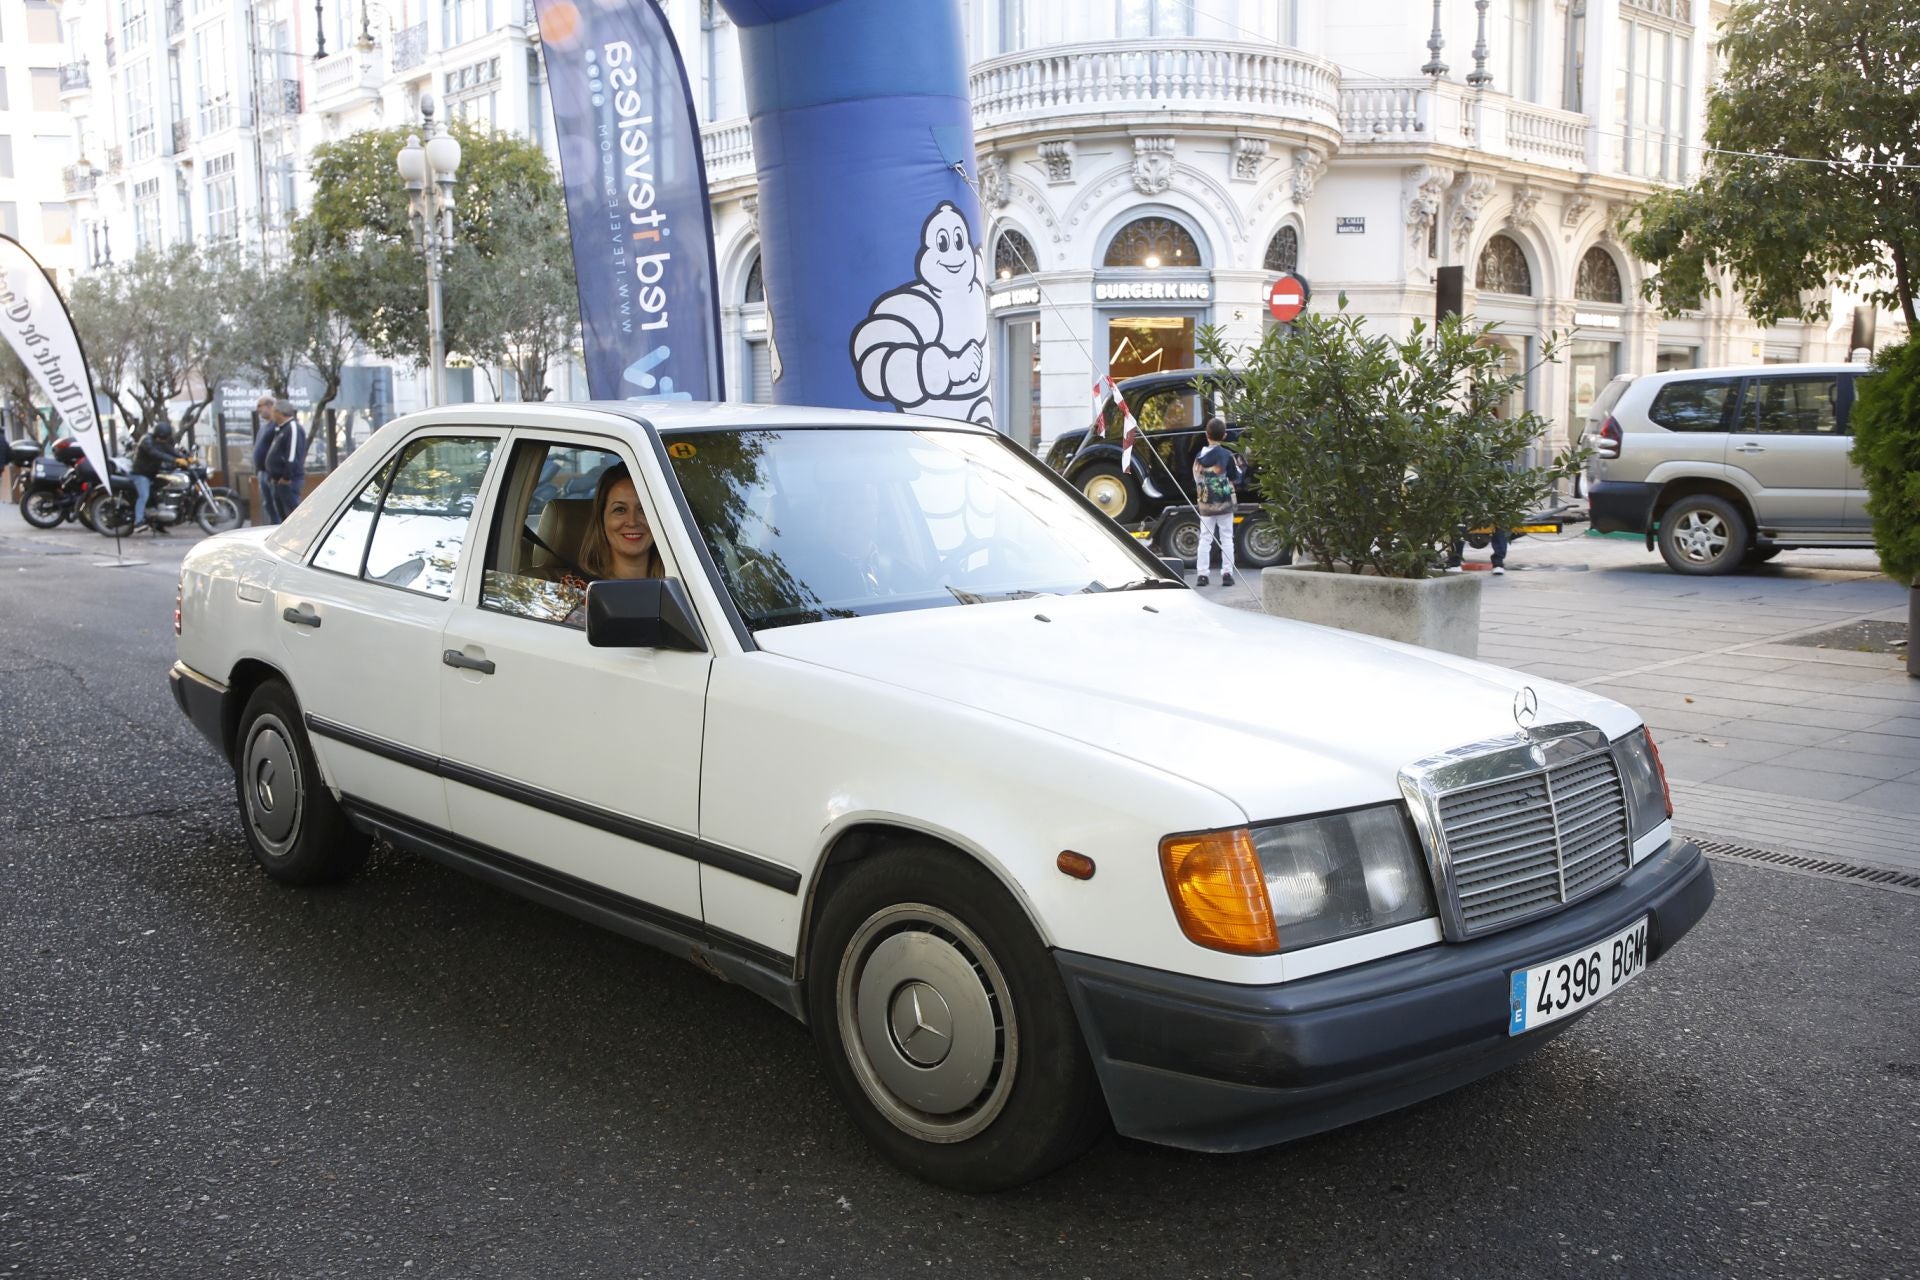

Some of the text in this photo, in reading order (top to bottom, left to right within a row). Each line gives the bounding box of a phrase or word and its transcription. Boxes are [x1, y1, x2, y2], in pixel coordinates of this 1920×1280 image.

[1095, 283, 1210, 300] BURGER KING
[1515, 925, 1645, 1023] E 4396 BGM
